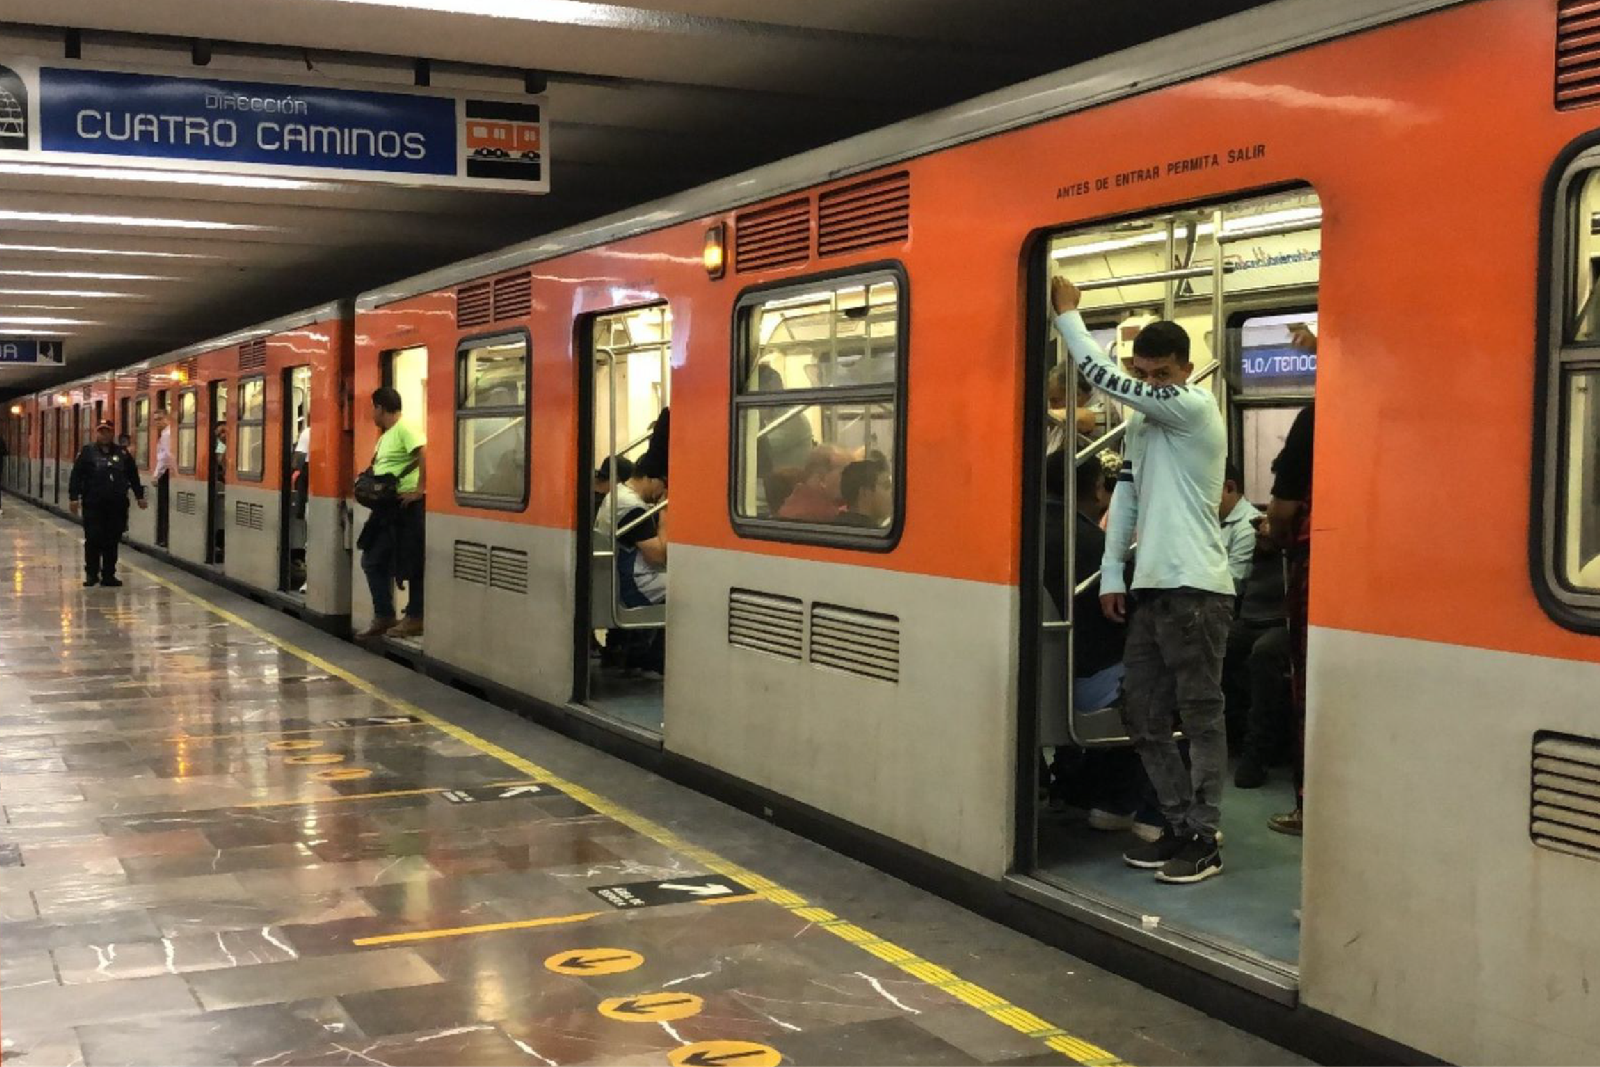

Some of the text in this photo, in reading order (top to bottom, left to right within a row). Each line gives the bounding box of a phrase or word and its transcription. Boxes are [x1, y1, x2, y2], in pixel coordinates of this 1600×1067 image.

[76, 110, 426, 159] CUATRO CAMINOS
[1056, 144, 1266, 200] ANTES DE ENTRAR PERMITA SALIR
